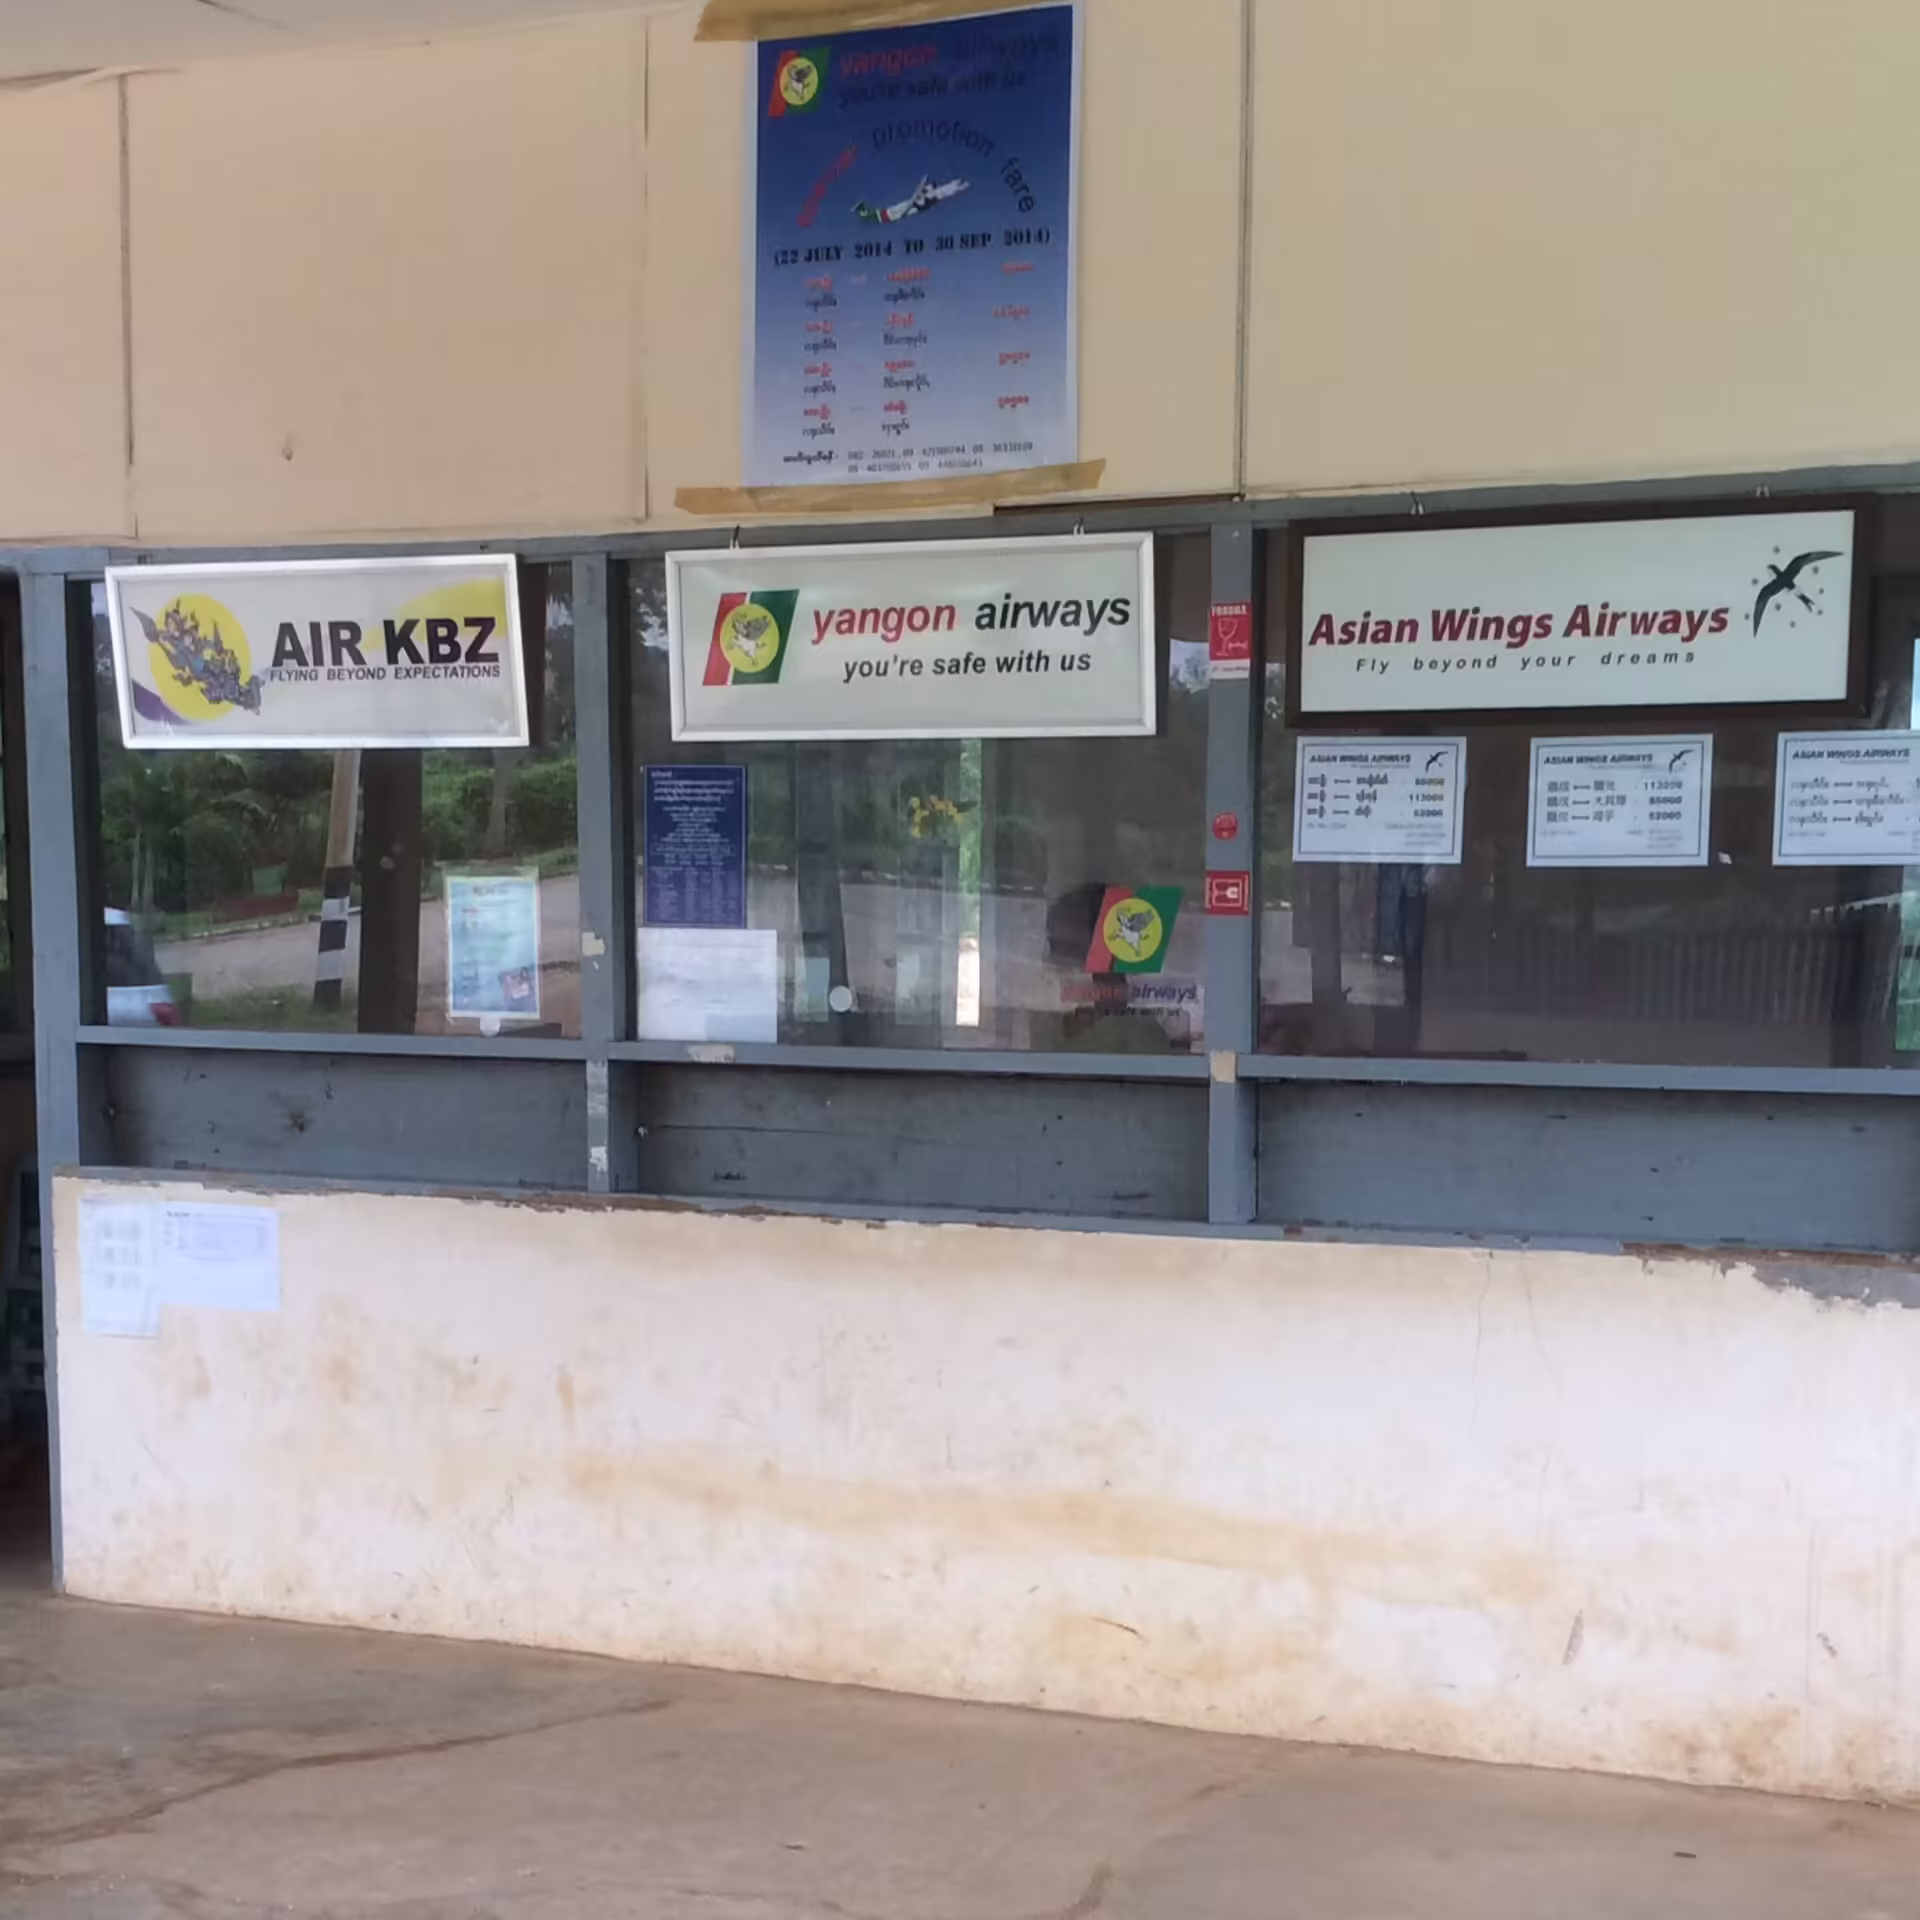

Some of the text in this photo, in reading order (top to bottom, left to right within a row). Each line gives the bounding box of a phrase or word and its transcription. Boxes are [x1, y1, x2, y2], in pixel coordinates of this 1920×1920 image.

[871, 118, 1035, 213] promotion fare
[803, 244, 845, 264] JULY
[854, 242, 893, 259] 2014
[903, 240, 926, 256] TO
[959, 233, 993, 252] SEP
[1003, 229, 1051, 248] 2014)
[811, 592, 1132, 645] yangon airways
[1308, 602, 1730, 649] Asian Wings Airways
[271, 616, 499, 668] AIR KBZ
[270, 664, 501, 682] FLYING BEYOND EXPECTATIONS
[843, 650, 1092, 684] you're safe with us
[1354, 650, 1697, 674] Fly beyond your dreams
[1133, 983, 1197, 1004] airways
